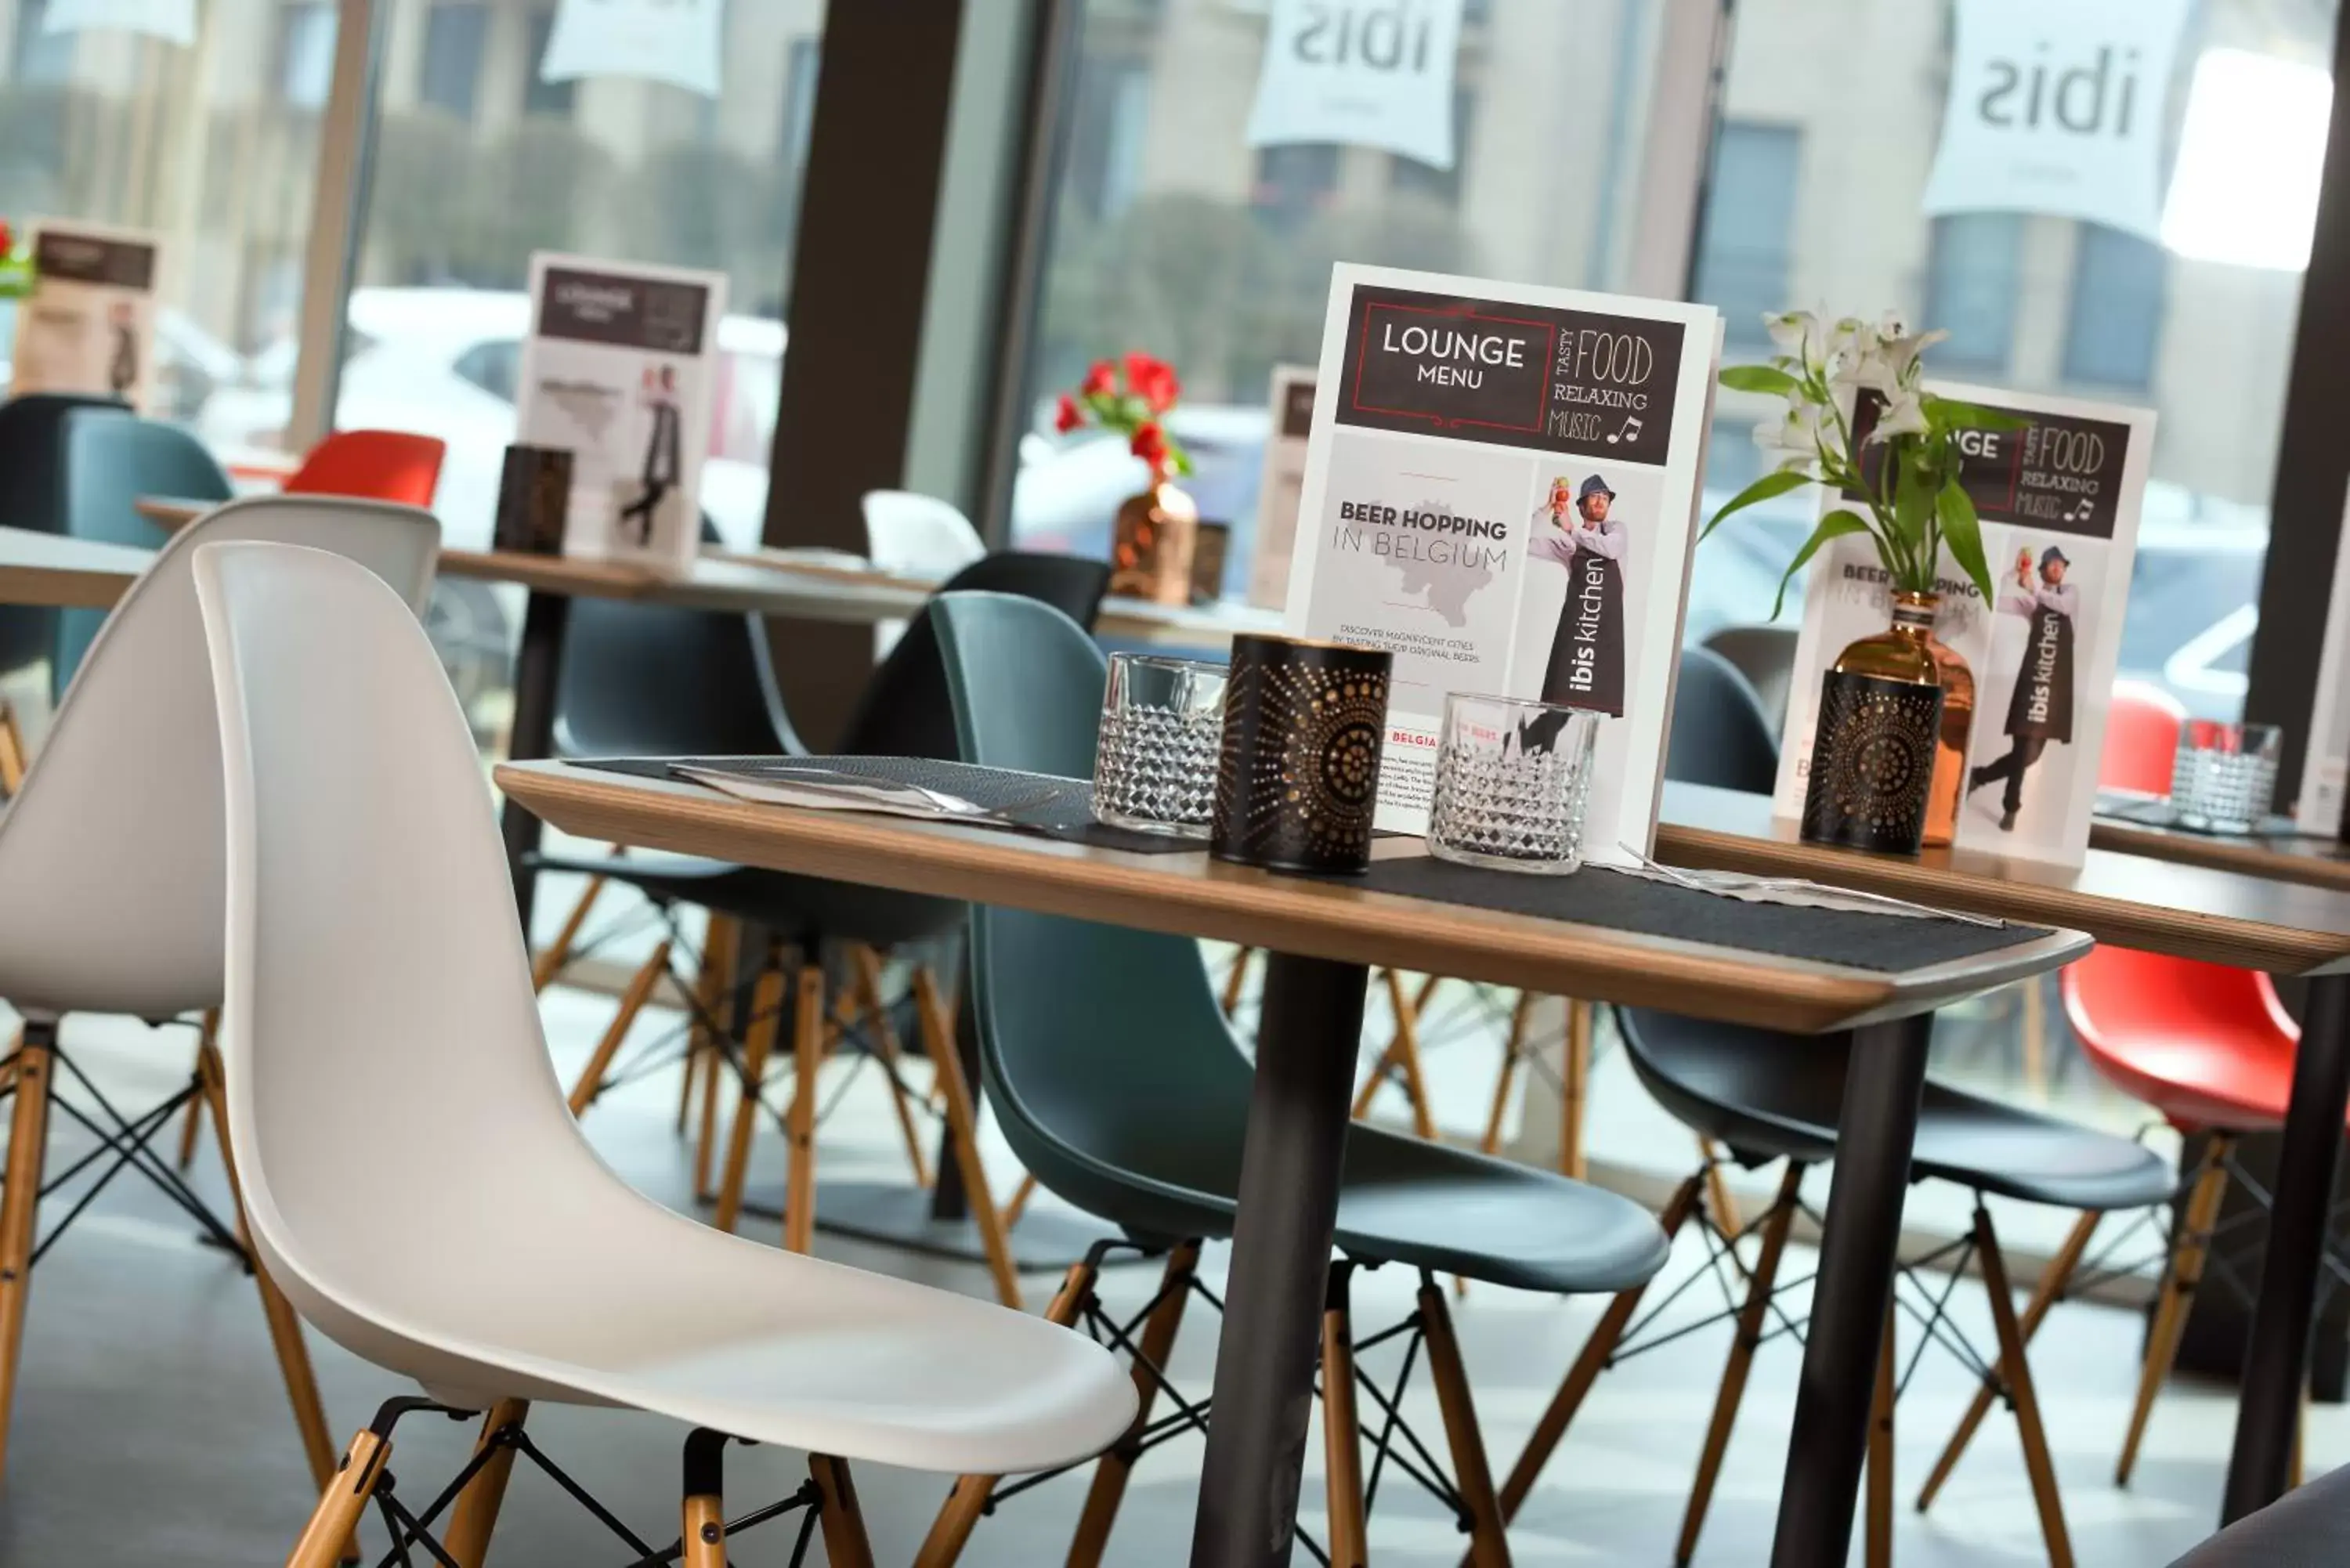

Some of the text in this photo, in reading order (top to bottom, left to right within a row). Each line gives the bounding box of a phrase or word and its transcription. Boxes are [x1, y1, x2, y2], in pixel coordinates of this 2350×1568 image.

[1383, 323, 1526, 368] LOUNGE
[1556, 328, 1574, 376] TASTY
[1574, 329, 1653, 385] FOOD
[1417, 364, 1484, 389] MENU
[1554, 383, 1647, 411] RELAXING
[1548, 408, 1602, 441] MUSIC
[2039, 427, 2106, 475] FOOD
[2020, 471, 2099, 495] RELAXING
[1340, 501, 1507, 540] BEER HOPPING
[2015, 492, 2062, 519] MUSIC
[1333, 526, 1507, 572] IN BELGIUM
[1843, 564, 1890, 585] BEER
[1569, 557, 1604, 692] ibis kitchen
[2027, 612, 2059, 723] ibis kitchen
